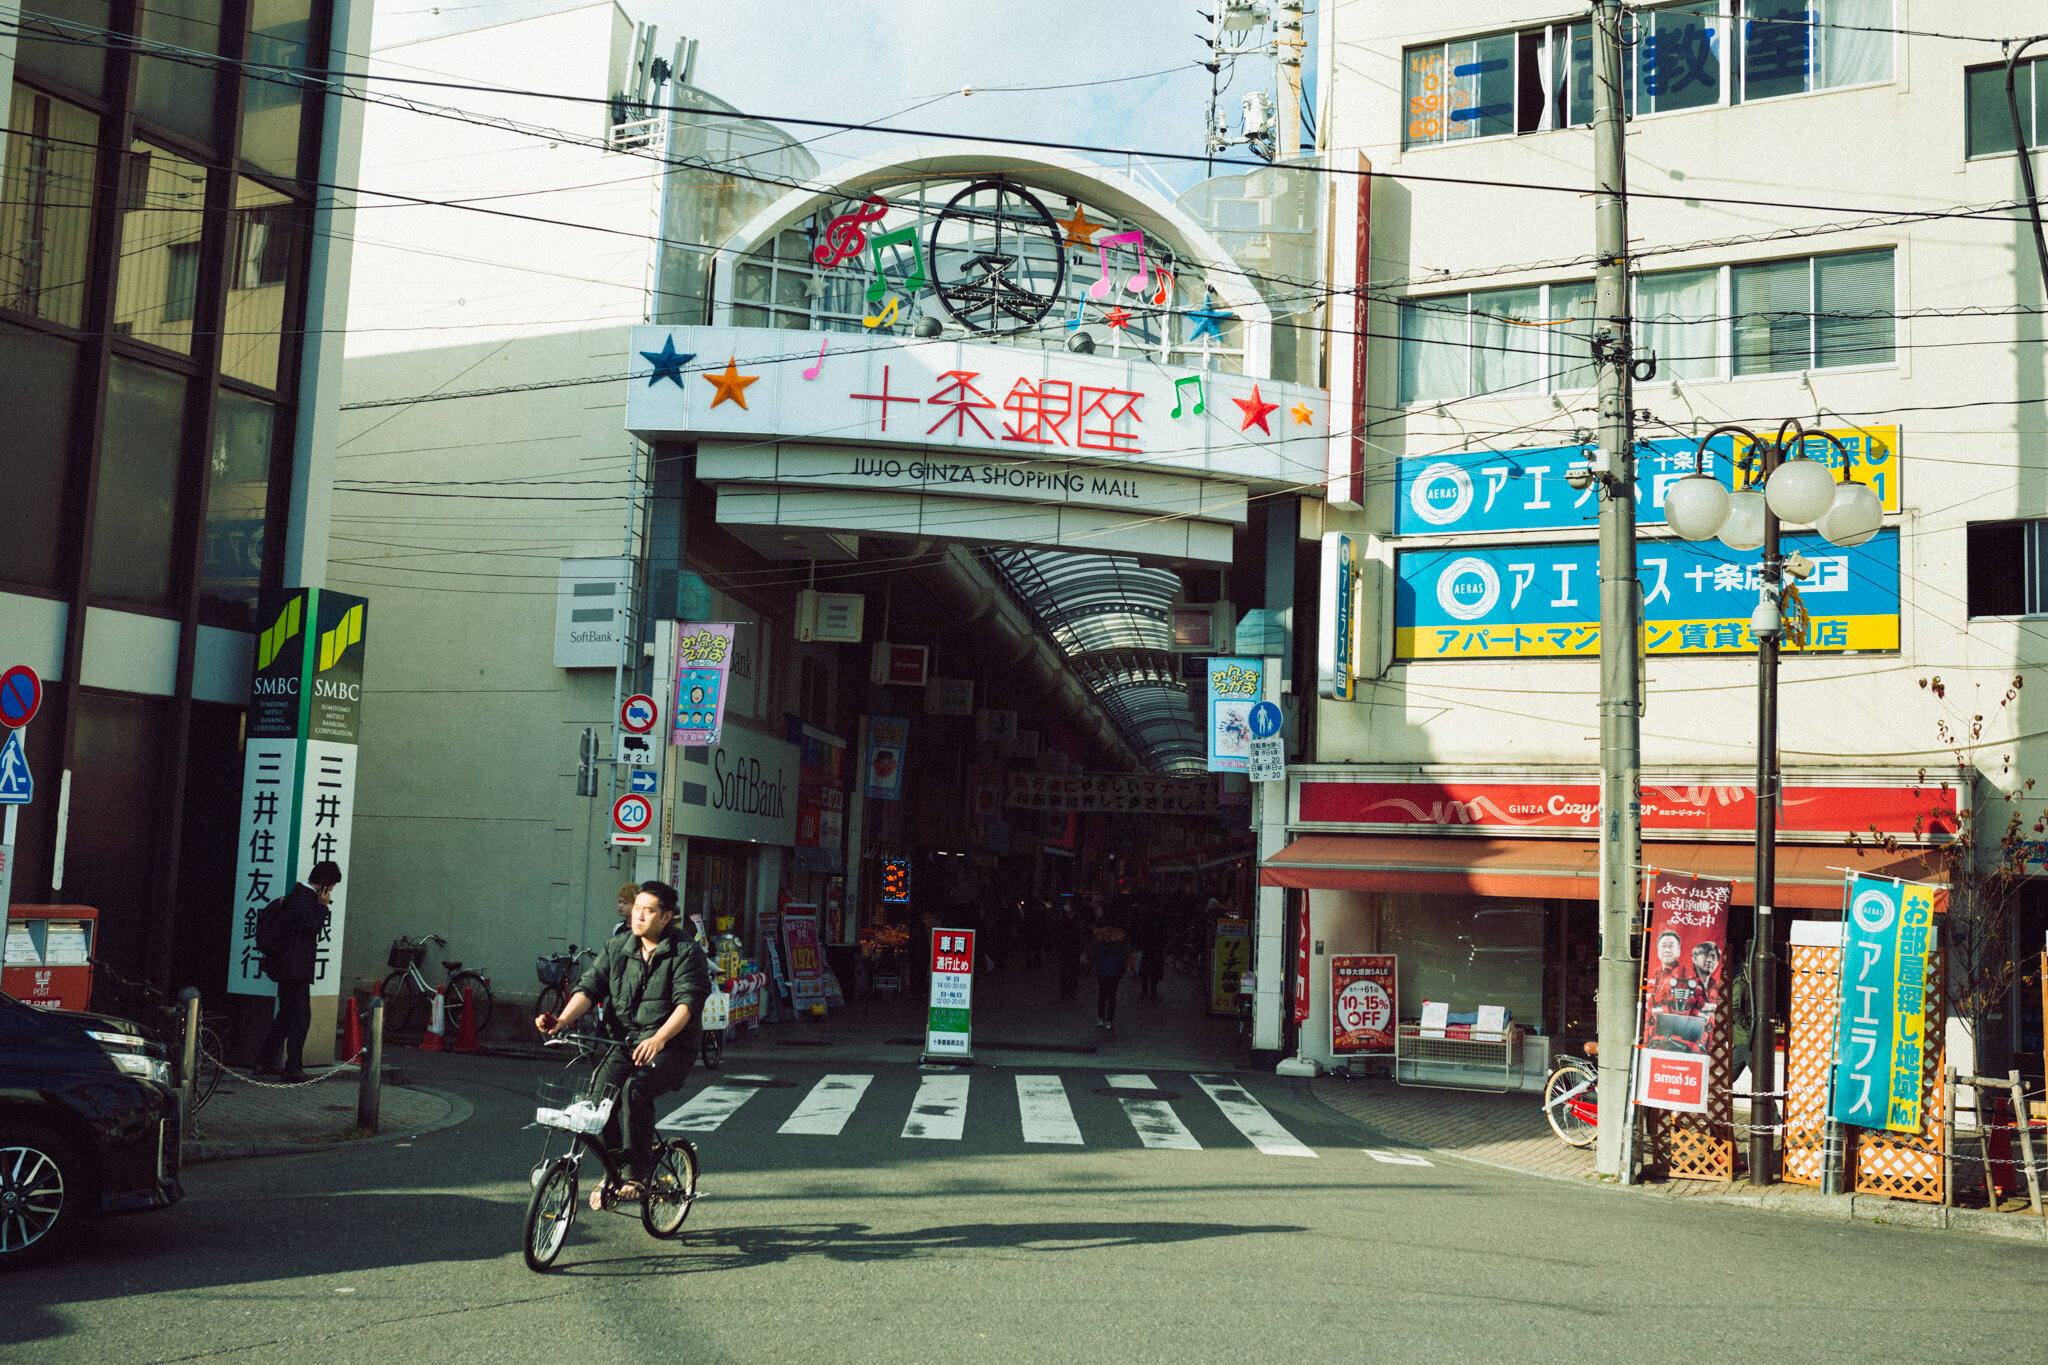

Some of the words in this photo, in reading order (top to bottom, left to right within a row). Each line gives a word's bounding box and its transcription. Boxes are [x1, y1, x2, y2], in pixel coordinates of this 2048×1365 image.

[849, 364, 1145, 455] 十条銀座
[1653, 450, 1715, 471] 十条店
[851, 457, 902, 480] JUJO
[908, 460, 977, 484] GINZA
[981, 465, 1086, 493] SHOPPING
[1089, 472, 1141, 500] MALL
[1427, 486, 1458, 500] AERAS
[1453, 582, 1484, 595] AERAS
[1507, 557, 1671, 612] アエス
[570, 630, 613, 644] SoftBank
[1436, 619, 1848, 654] アパート・マンン賃貸店
[253, 677, 299, 696] SMBC
[314, 678, 360, 702] SMBC
[260, 700, 289, 708] SUMITOMO
[321, 703, 351, 713] SUMITOMO
[254, 724, 291, 732] CORPORATION
[260, 716, 285, 724] BANKING
[322, 719, 347, 729] BANKING
[314, 727, 353, 738] CORPORATION
[712, 748, 786, 819] SoftBank
[1253, 772, 1260, 780] 12
[1271, 771, 1281, 779] 20
[621, 804, 644, 823] 20
[1508, 804, 1545, 814] GINZA
[1547, 794, 1598, 823] Cozy
[1863, 906, 1883, 918] AERAS
[940, 935, 966, 953] 車両
[936, 956, 969, 971] 通行止め
[33, 987, 50, 997] POST
[1347, 1010, 1382, 1027] OFF
[1848, 940, 1882, 1117] アエラス
